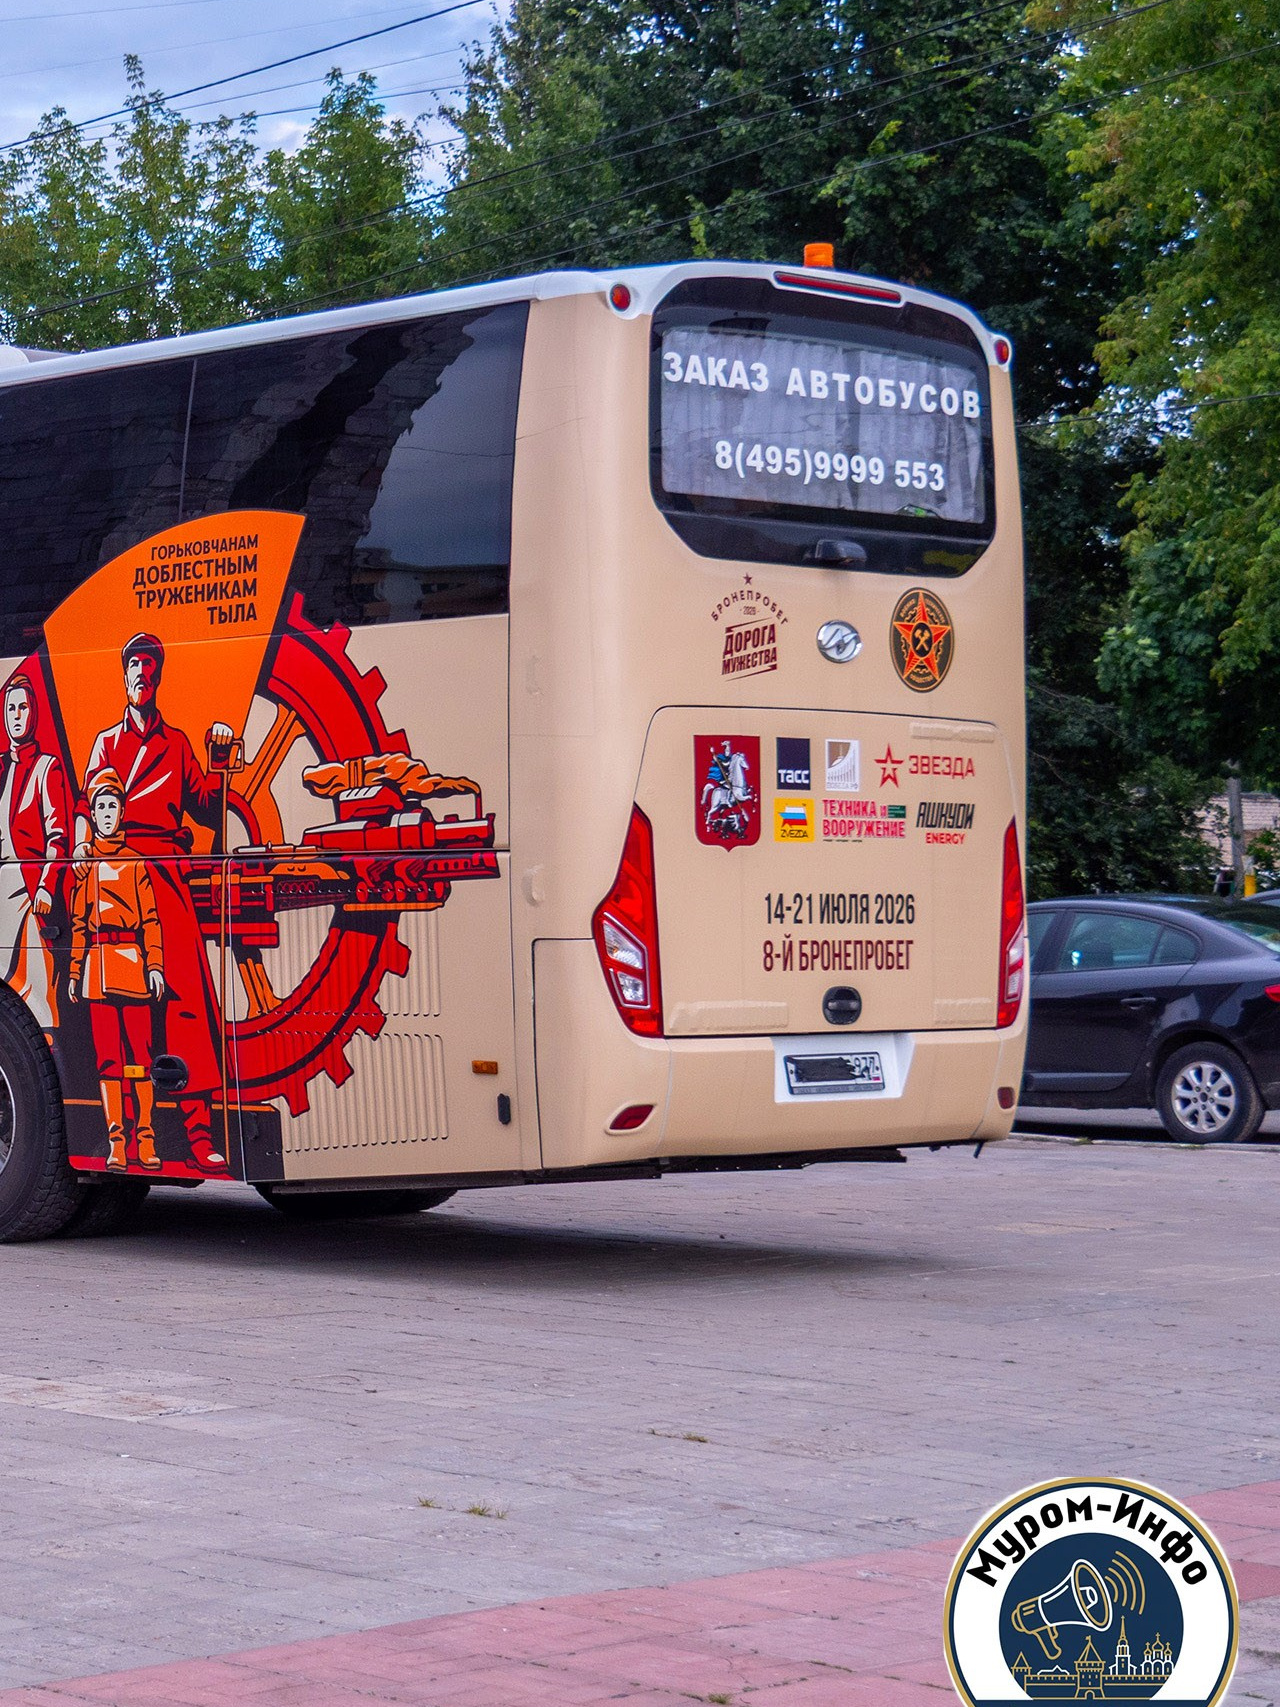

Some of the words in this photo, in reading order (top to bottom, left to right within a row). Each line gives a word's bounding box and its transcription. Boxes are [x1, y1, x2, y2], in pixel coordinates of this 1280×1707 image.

[663, 352, 769, 392] ЗАКАЗ
[786, 368, 981, 418] АВТОБУСОВ
[715, 441, 884, 485] 8(495)9999
[895, 460, 945, 491] 553
[151, 534, 258, 561] ГОРЬКОВЧАНАМ
[133, 554, 257, 589] ДОБЛЕСТНЫМ
[135, 578, 257, 609] ТРУЖЕНИКАМ
[711, 590, 788, 625] БРОНЕПРОБЕГ
[207, 602, 257, 625] ТЫЛА
[723, 623, 776, 659] ДОРОГА
[721, 647, 777, 675] МУЖЕСТВА
[908, 755, 975, 779] ЗВЕЗДА
[822, 800, 877, 818] ТЕХНИКА
[781, 829, 808, 838] ZVEZDA
[822, 819, 905, 838] ВООРУЖЕНИЕ
[925, 832, 965, 844] ENERGY
[765, 893, 812, 924] 14-21
[819, 893, 869, 924] ИЮЛЯ
[875, 894, 915, 924] 2026
[763, 933, 793, 972] 8-Й
[798, 940, 914, 971] БРОНЕПРОБЕГ
